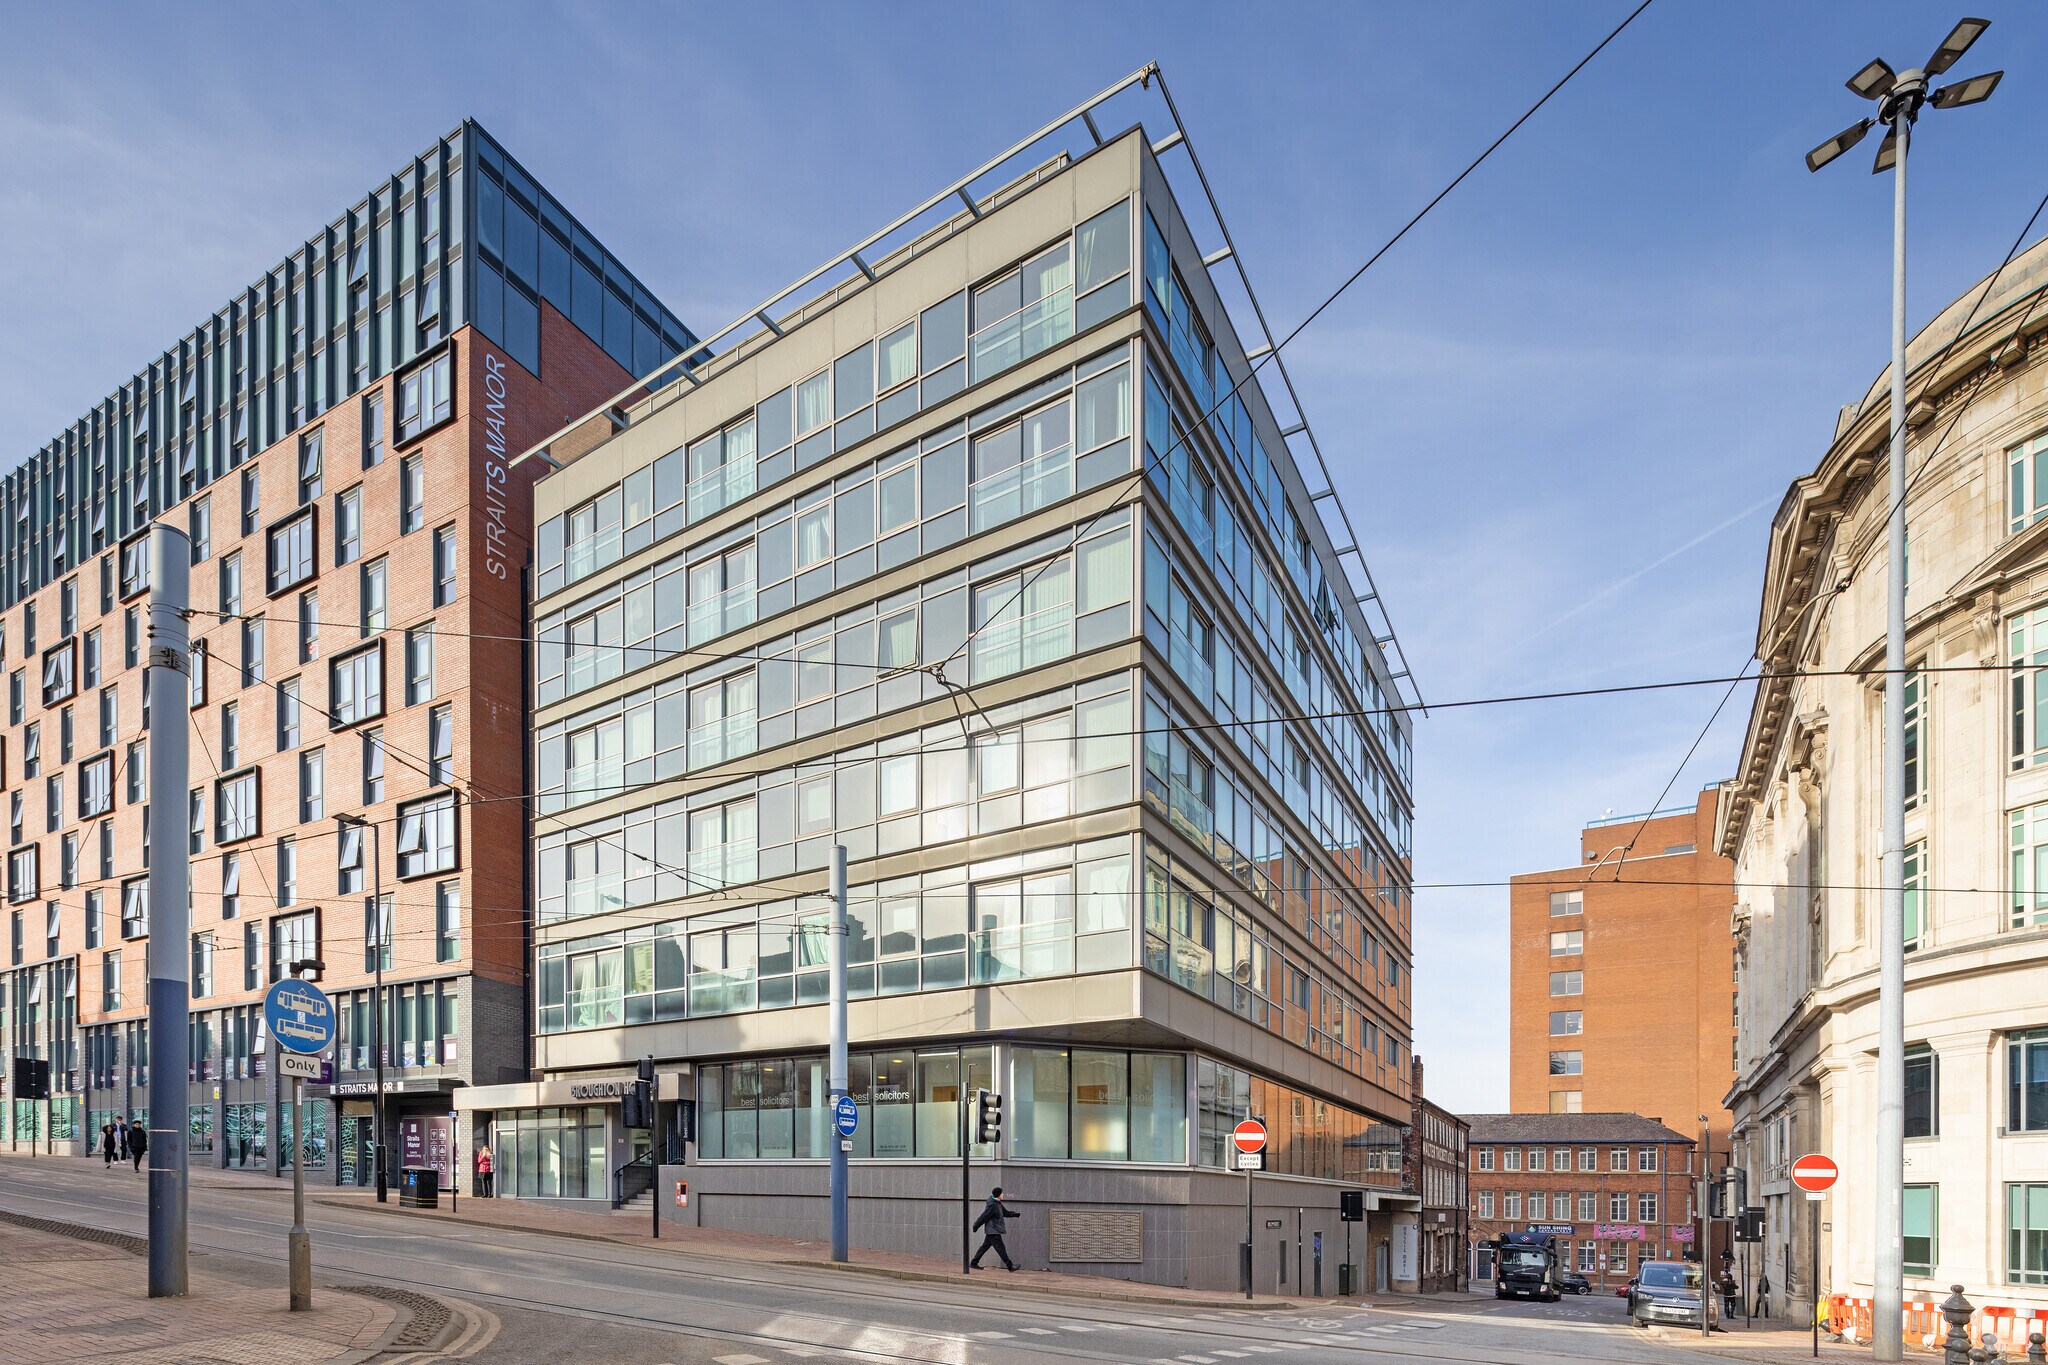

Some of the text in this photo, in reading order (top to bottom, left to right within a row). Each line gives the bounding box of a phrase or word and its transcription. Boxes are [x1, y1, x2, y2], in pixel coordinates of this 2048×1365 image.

[485, 353, 507, 580] STRAITS MANOR
[286, 1059, 315, 1075] Only
[339, 1082, 393, 1093] STRAITS MAOR
[571, 1083, 621, 1097] BROUGHTON
[740, 1096, 790, 1107] best solicitors
[852, 1090, 910, 1102] best solicitors
[1133, 1092, 1176, 1103] solicrs
